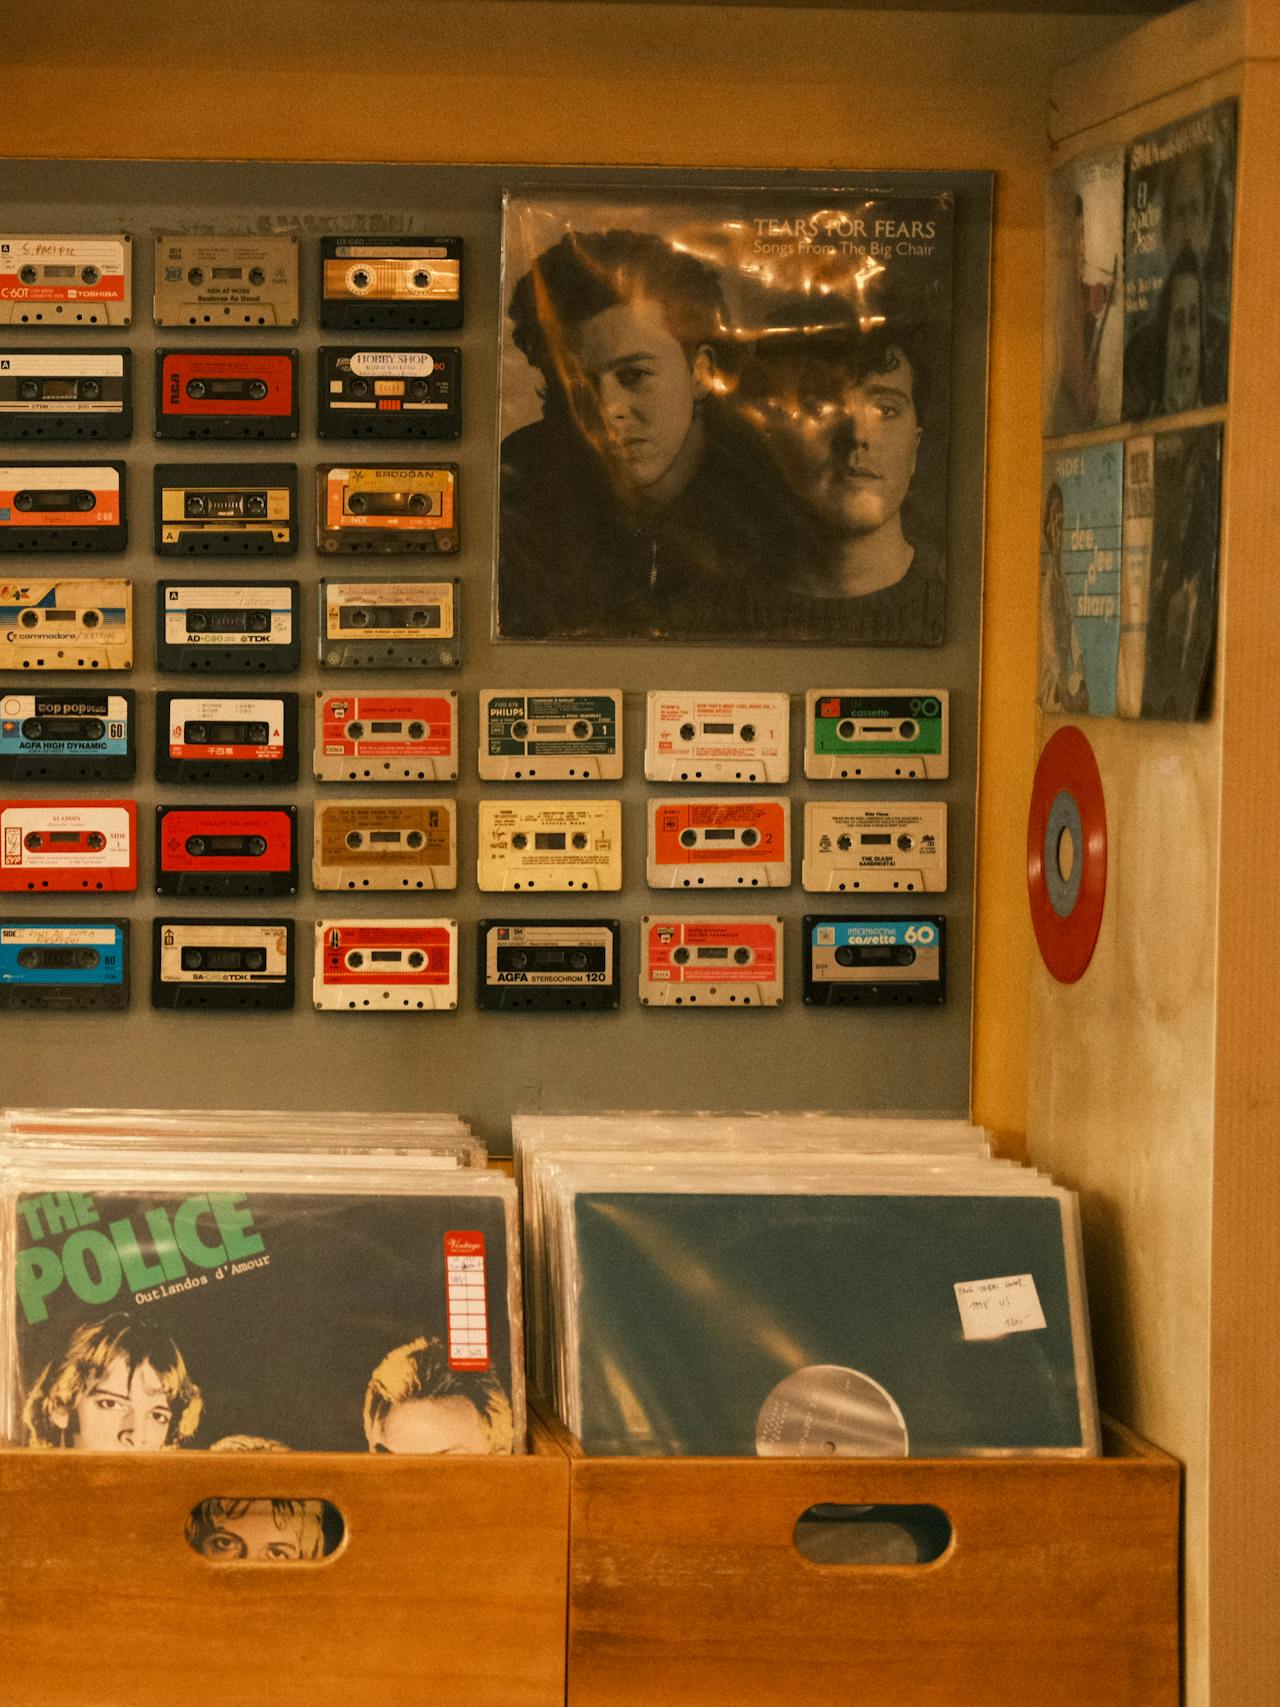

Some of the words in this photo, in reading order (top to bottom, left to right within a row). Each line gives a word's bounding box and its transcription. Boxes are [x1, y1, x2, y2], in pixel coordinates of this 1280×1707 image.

[754, 218, 818, 238] TEARS
[826, 218, 868, 239] FOR
[875, 220, 936, 239] FEARS
[2, 245, 11, 253] A
[754, 239, 794, 258] Songs
[798, 242, 836, 256] From
[839, 241, 866, 256] The
[870, 242, 892, 259] Big
[896, 242, 936, 256] Chair
[77, 290, 119, 298] TOSHIBA
[357, 354, 396, 364] HOBBY
[398, 354, 429, 364] SHOP
[166, 532, 174, 540] A
[18, 632, 76, 640] commodore
[249, 634, 270, 642] TDK
[490, 708, 524, 716] PHILIPS
[851, 709, 889, 717] cassette
[909, 699, 938, 717] 90
[110, 723, 123, 737] 60
[601, 724, 607, 736] 1
[43, 742, 65, 750] HIGH
[66, 742, 107, 750] DYNAMIC
[766, 833, 773, 844] 2
[847, 936, 898, 944] cassette
[904, 926, 935, 944] 60
[497, 973, 528, 982] AGFA
[586, 973, 606, 982] 120
[15, 1191, 100, 1242] THE
[448, 1238, 481, 1251] Vintage
[14, 1191, 266, 1326] POLICE
[134, 1276, 209, 1305] Outlandos
[214, 1254, 271, 1282] d'Amour
